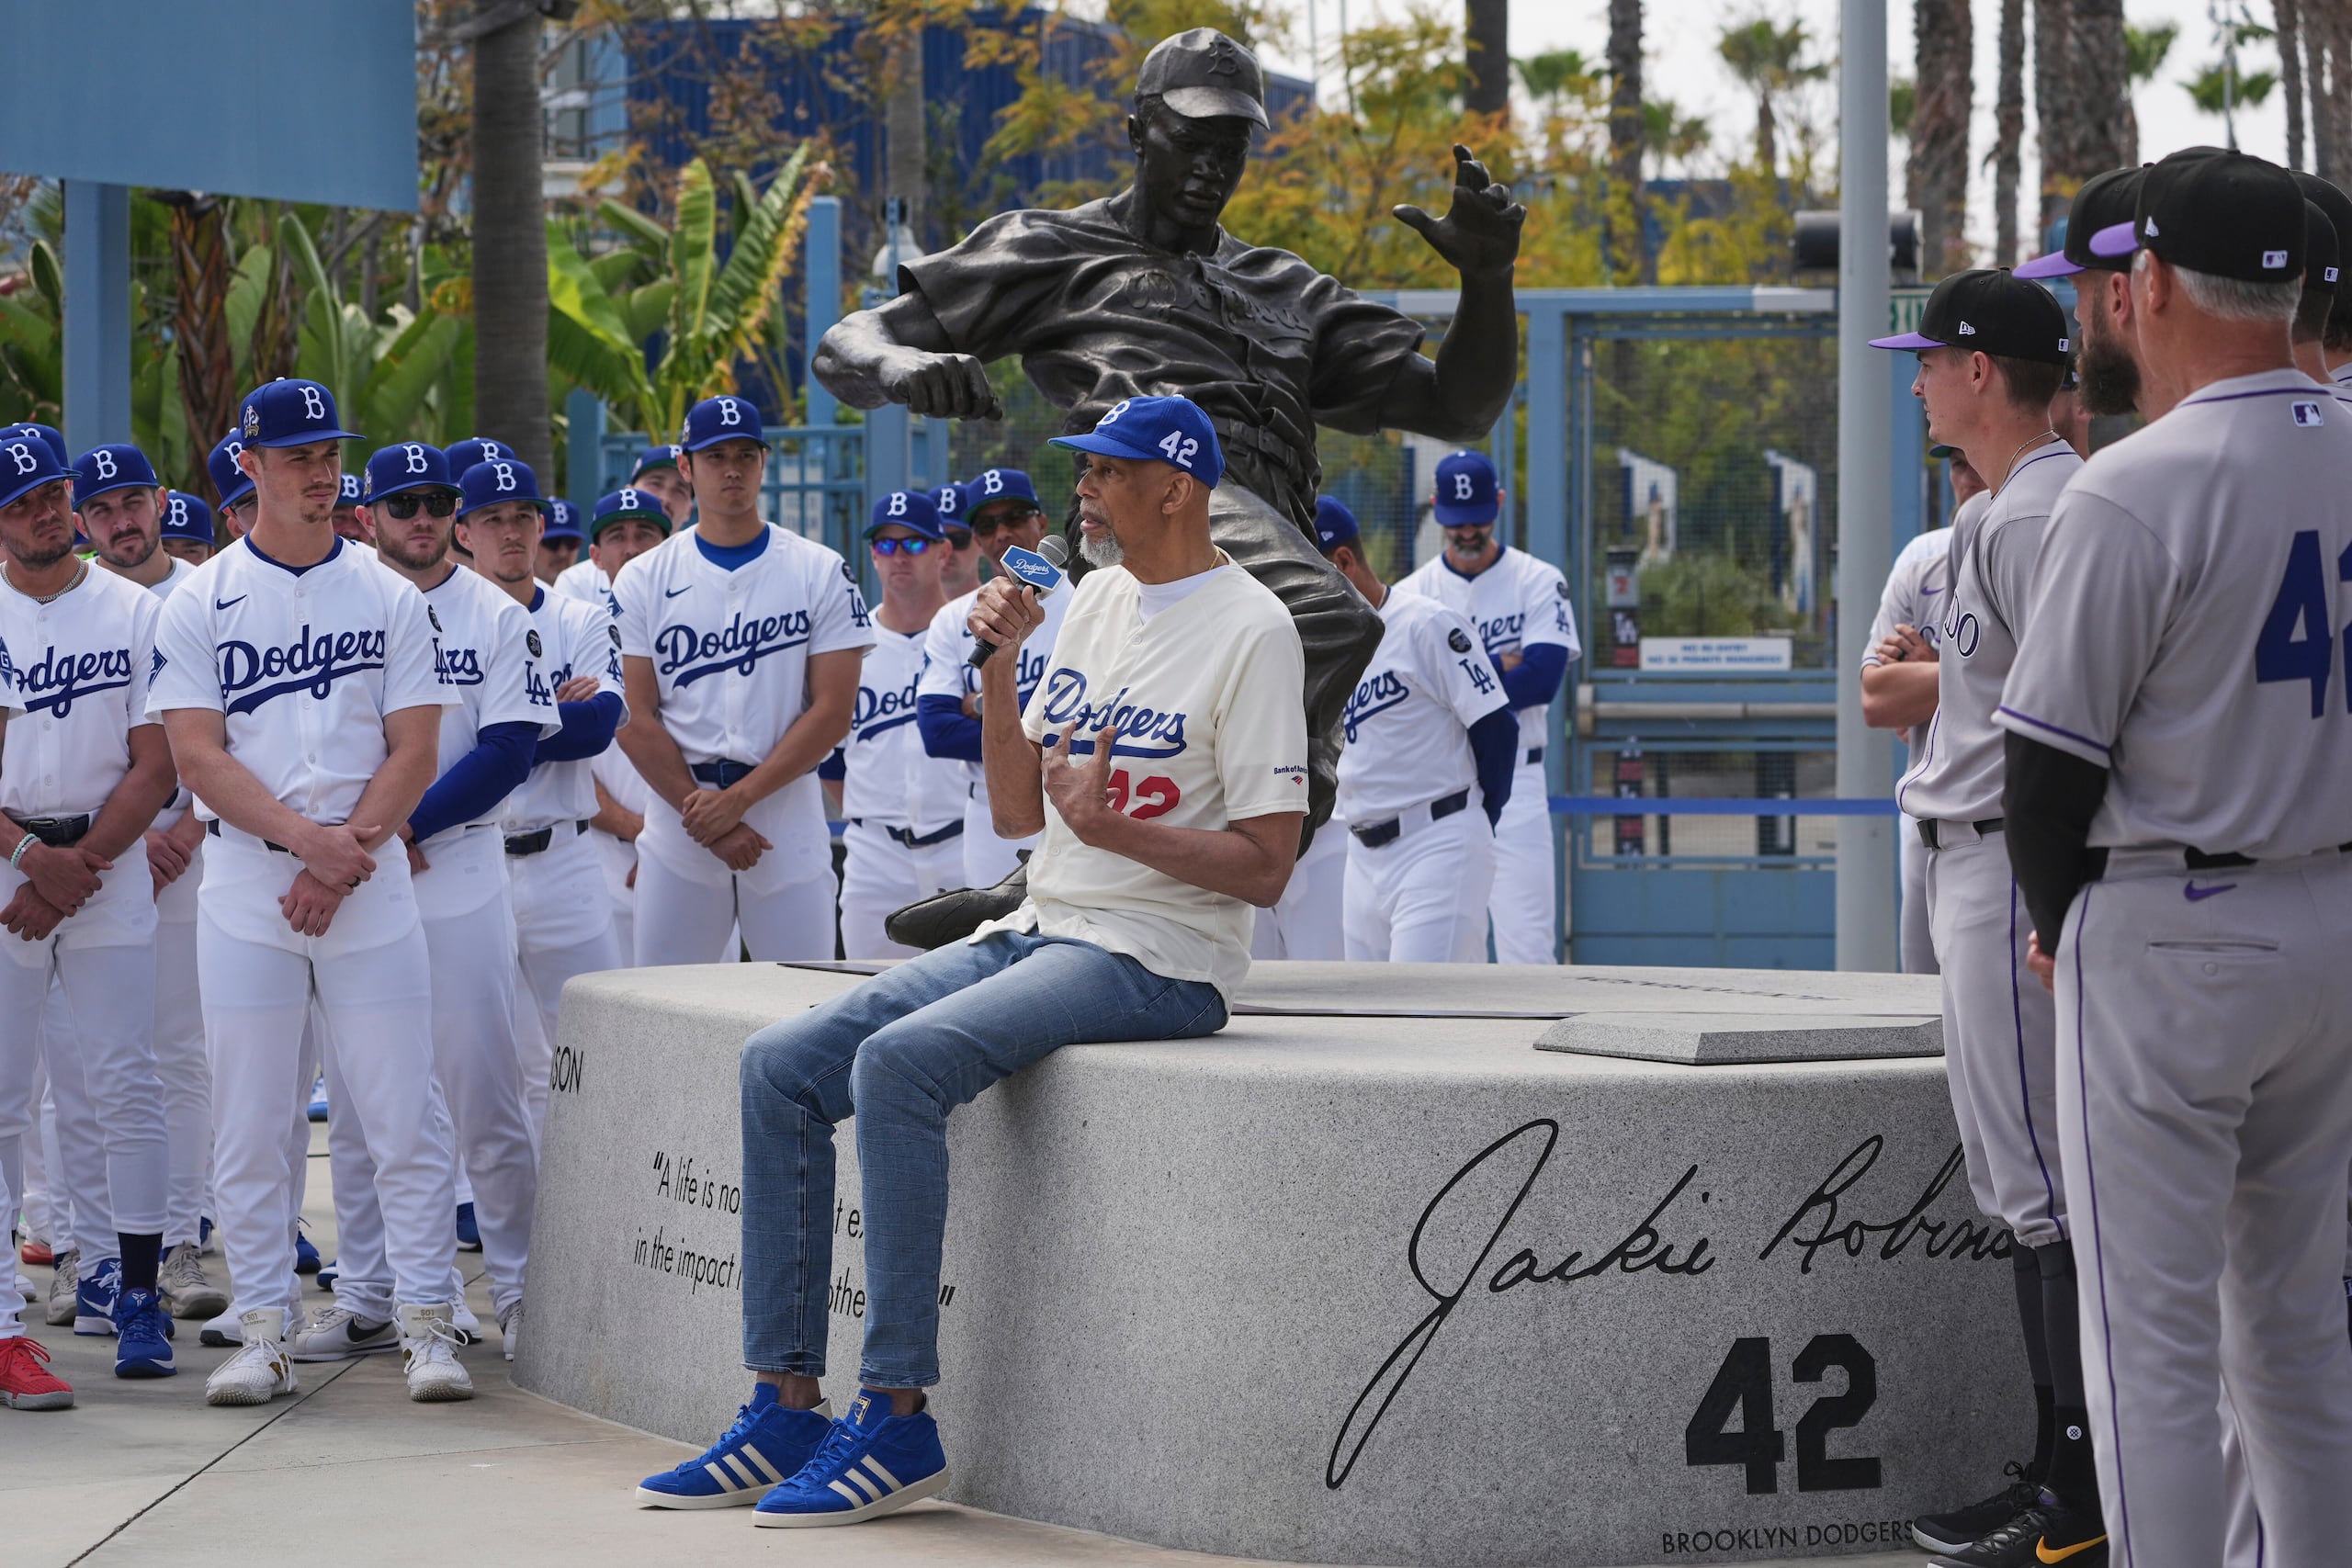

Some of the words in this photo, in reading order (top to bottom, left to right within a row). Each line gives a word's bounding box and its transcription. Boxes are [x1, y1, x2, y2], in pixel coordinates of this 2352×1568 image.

[299, 387, 325, 419] B
[718, 399, 741, 425] B
[1096, 400, 1130, 426] B
[6, 444, 37, 475] B
[402, 445, 428, 473] B
[1159, 430, 1199, 468] 42
[93, 450, 118, 480] B
[492, 463, 516, 491] B
[342, 475, 358, 499] B
[983, 468, 1003, 495] B
[1453, 473, 1473, 500] B
[168, 499, 188, 526] B
[552, 503, 569, 524] B
[619, 489, 639, 511] B
[887, 491, 908, 515] B
[938, 488, 956, 513] B
[1012, 558, 1049, 576] Dodgers
[847, 589, 871, 626] LA
[2256, 530, 2352, 718] 4
[655, 610, 810, 691] Dodgers
[13, 645, 130, 718] odgers
[217, 625, 384, 716] Dodgers
[525, 660, 552, 705] LA
[1458, 659, 1495, 695] LA
[1043, 668, 1187, 761] Dodgers
[674, 1156, 697, 1204] life
[702, 1168, 714, 1208] is
[718, 1184, 742, 1215] no
[634, 1226, 647, 1266] in
[650, 1225, 673, 1272] the
[677, 1237, 734, 1294] impact
[1326, 1118, 1716, 1490] Jackie
[1685, 1333, 1883, 1495] 42
[1662, 1526, 1798, 1554] BROOKLYN
[1806, 1519, 1914, 1547] DODGERS
